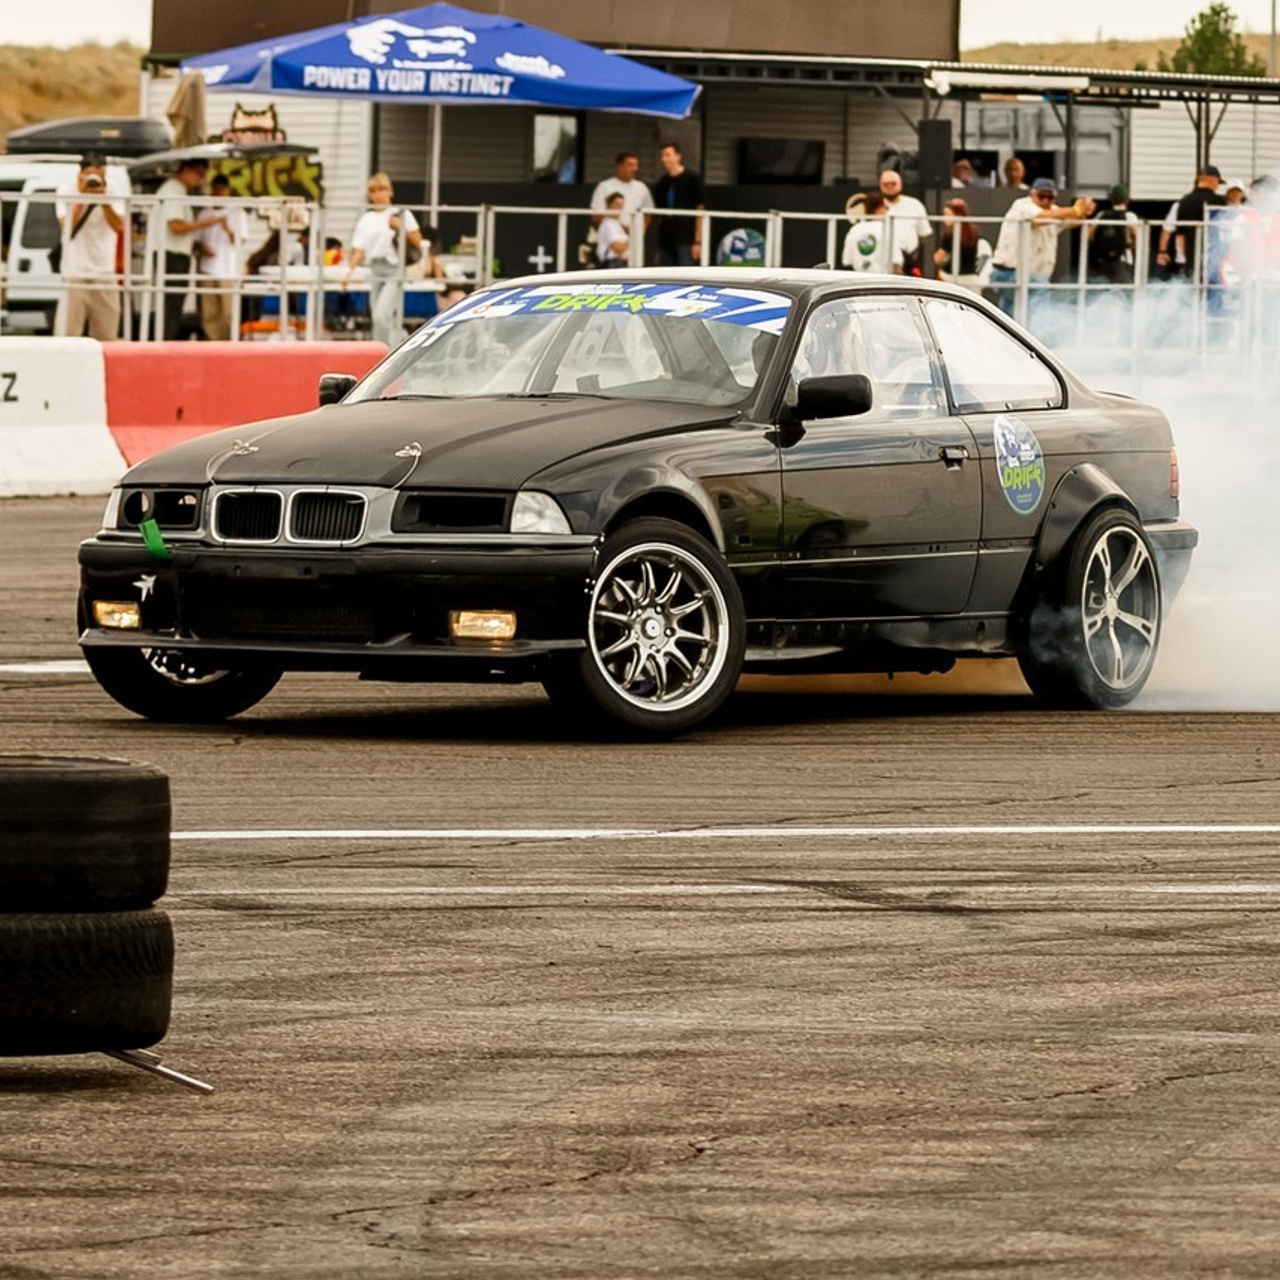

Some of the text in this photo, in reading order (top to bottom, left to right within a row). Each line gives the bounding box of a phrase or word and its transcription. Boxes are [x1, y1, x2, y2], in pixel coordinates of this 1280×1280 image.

[304, 66, 514, 95] POWER YOUR INSTINCT
[205, 154, 321, 203] RIFT
[531, 294, 649, 313] DRIFT
